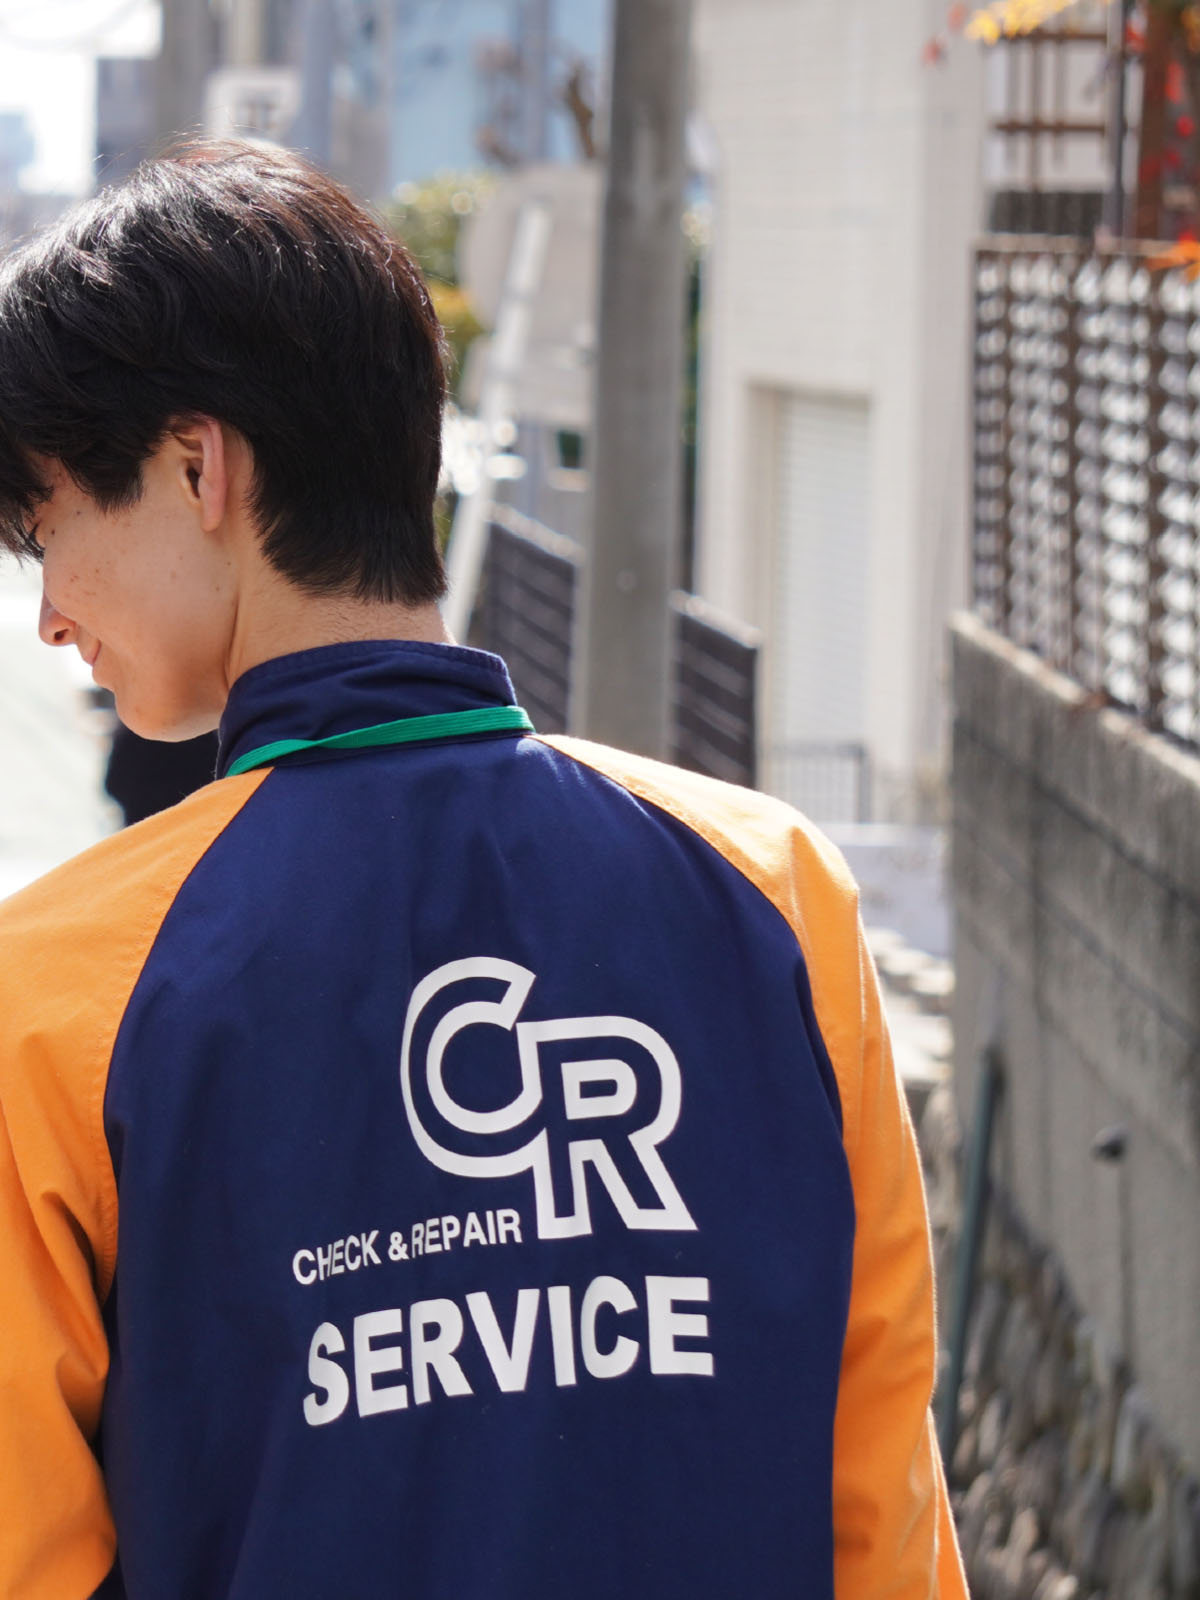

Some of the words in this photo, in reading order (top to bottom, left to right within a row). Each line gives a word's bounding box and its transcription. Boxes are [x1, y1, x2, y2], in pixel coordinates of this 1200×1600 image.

[400, 956, 699, 1240] CR
[292, 1229, 382, 1286] CHECK
[303, 1275, 714, 1426] SERVICE
